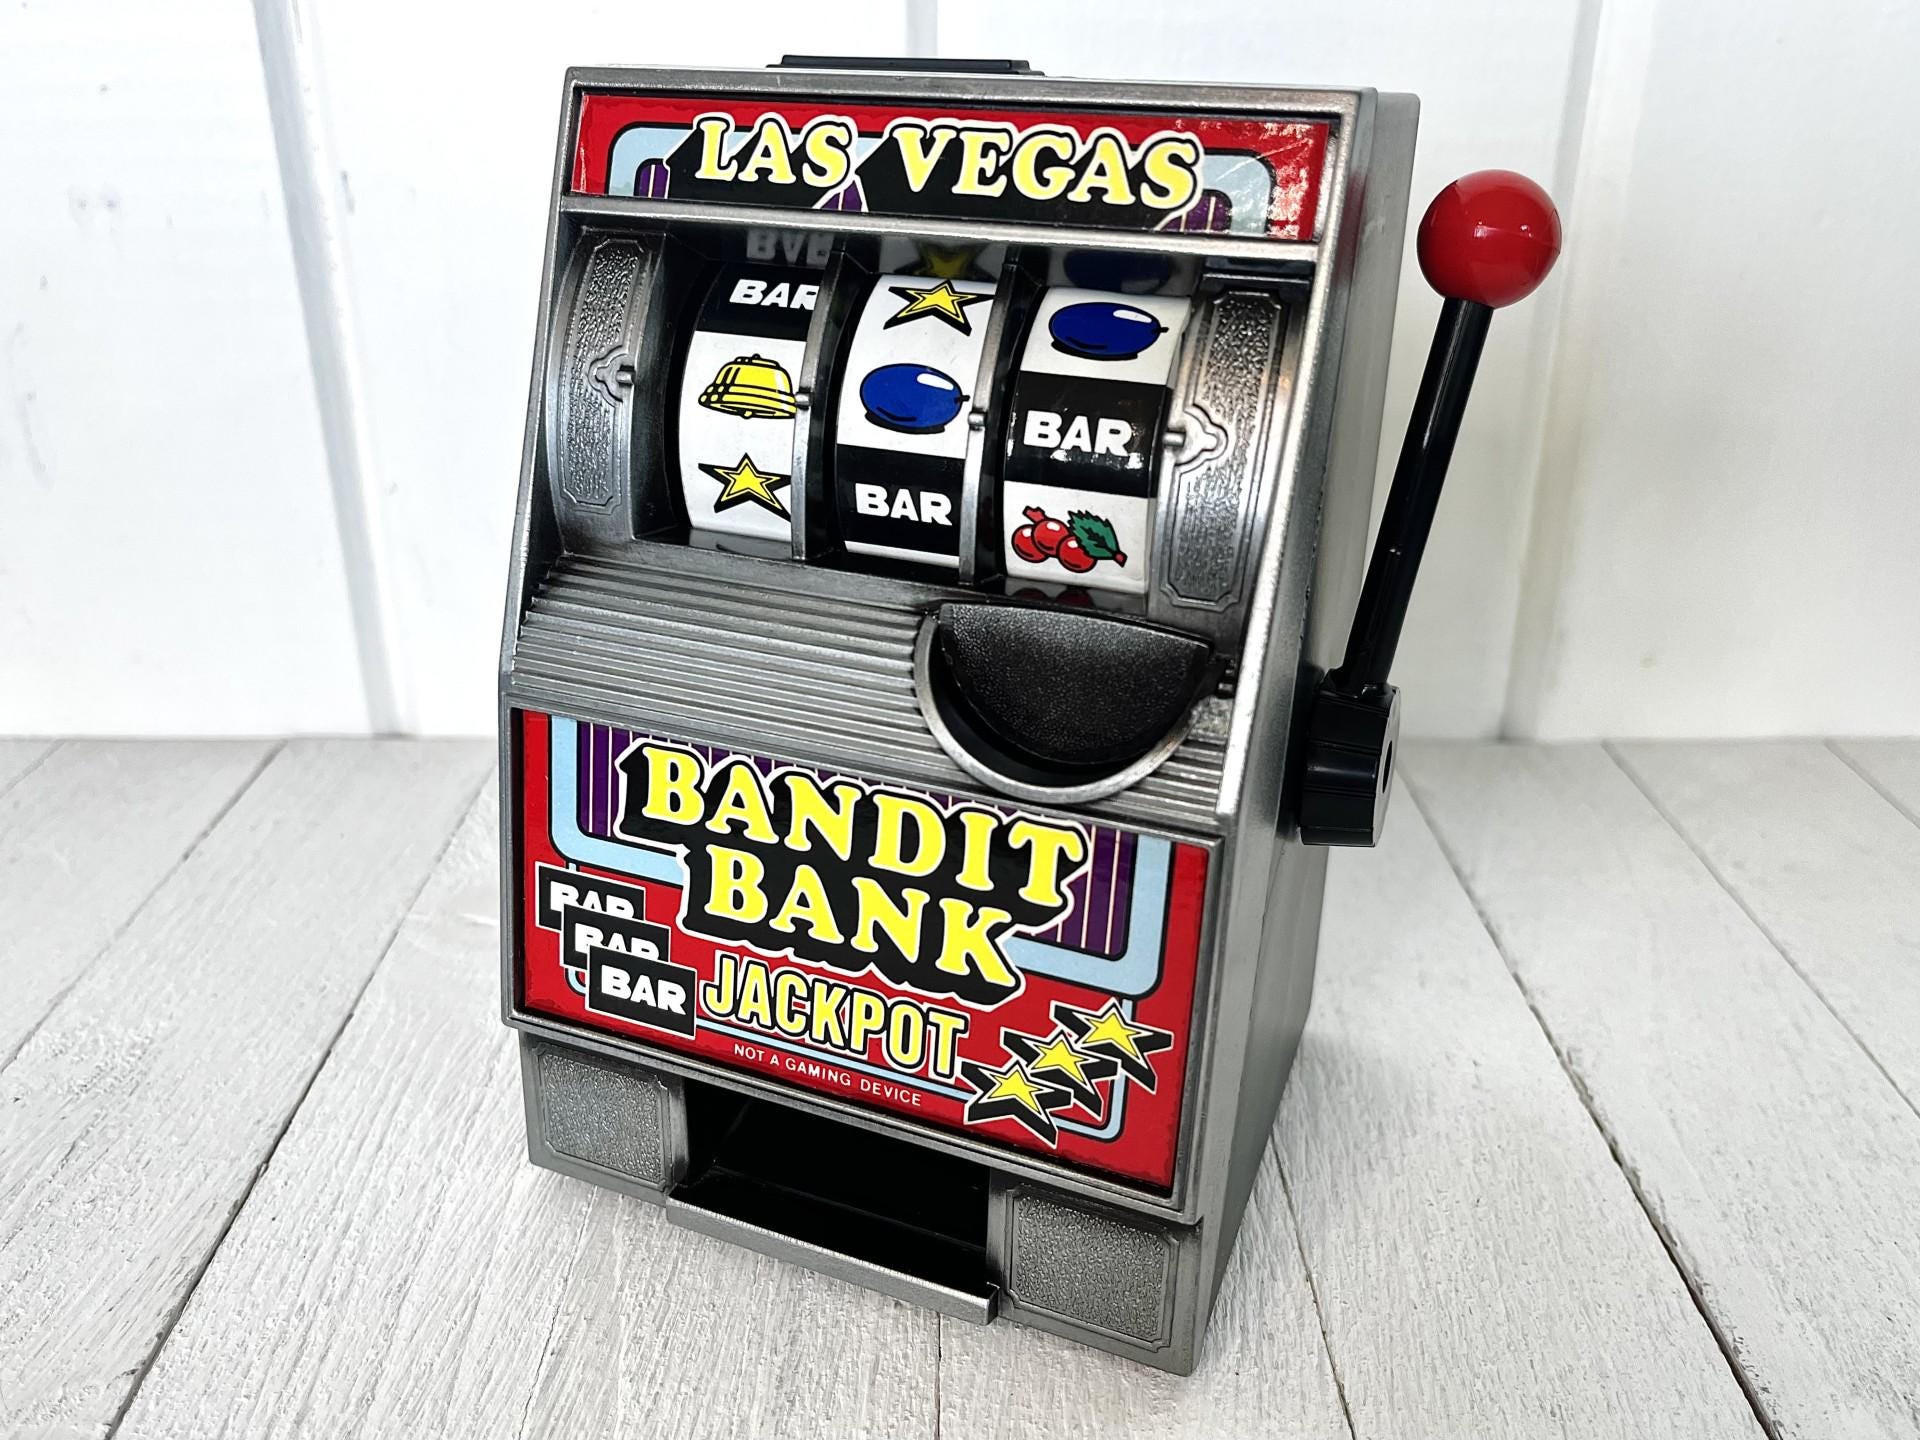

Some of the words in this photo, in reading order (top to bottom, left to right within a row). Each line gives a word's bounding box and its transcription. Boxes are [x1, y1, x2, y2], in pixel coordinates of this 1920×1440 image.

[694, 118, 850, 188] LAS
[890, 126, 1197, 207] VEGAS
[1022, 409, 1134, 458] BAR
[855, 482, 952, 526] BAR
[640, 744, 1087, 909] BANDIT
[703, 842, 1018, 990] BANK
[601, 964, 687, 1016] BAR
[702, 953, 968, 1079] JACKPOT
[733, 1043, 766, 1062] NOT
[769, 1053, 781, 1067] A
[785, 1057, 852, 1087] GAMING
[860, 1077, 922, 1107] DEVICE
